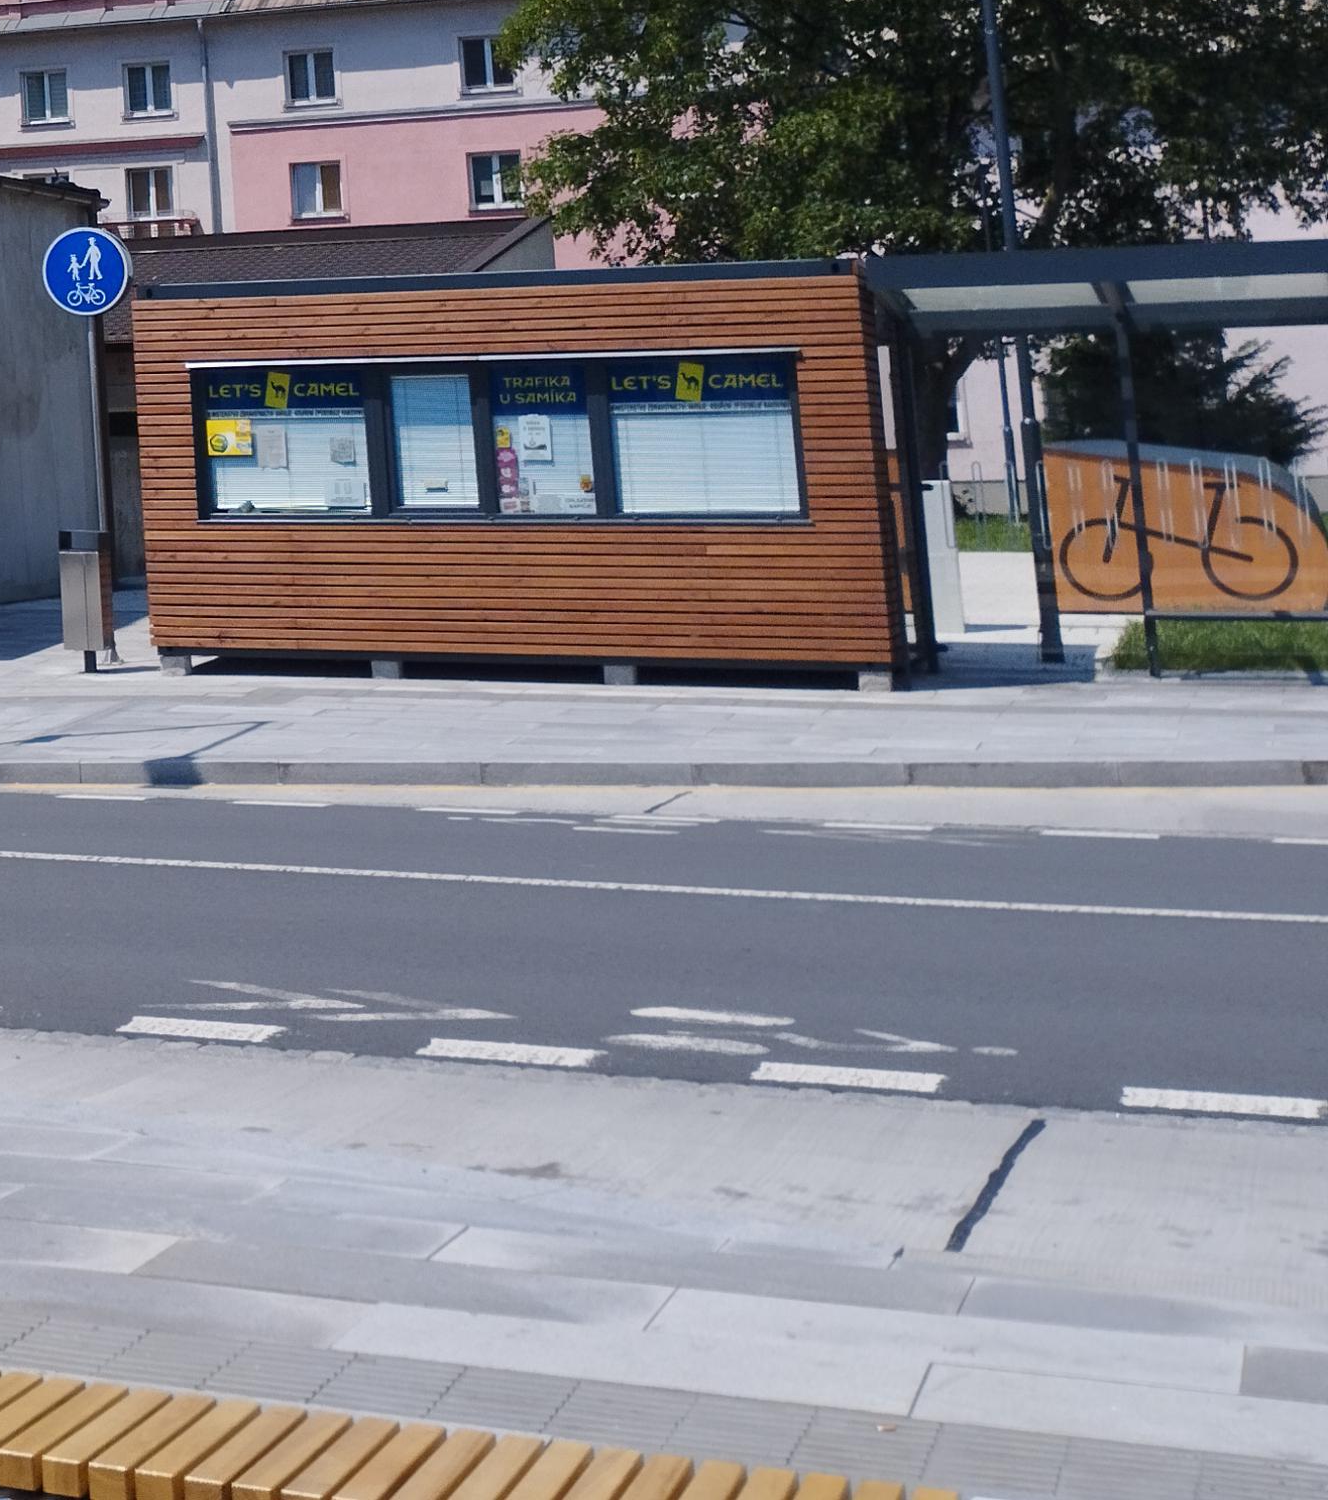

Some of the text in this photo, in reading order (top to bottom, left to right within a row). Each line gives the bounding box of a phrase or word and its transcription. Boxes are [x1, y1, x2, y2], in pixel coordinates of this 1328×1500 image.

[504, 375, 570, 389] TRAFIKA
[611, 374, 784, 390] LET'S CAMEL
[209, 383, 359, 398] LET'S CAMEL
[499, 389, 576, 404] U SAMÍKA
